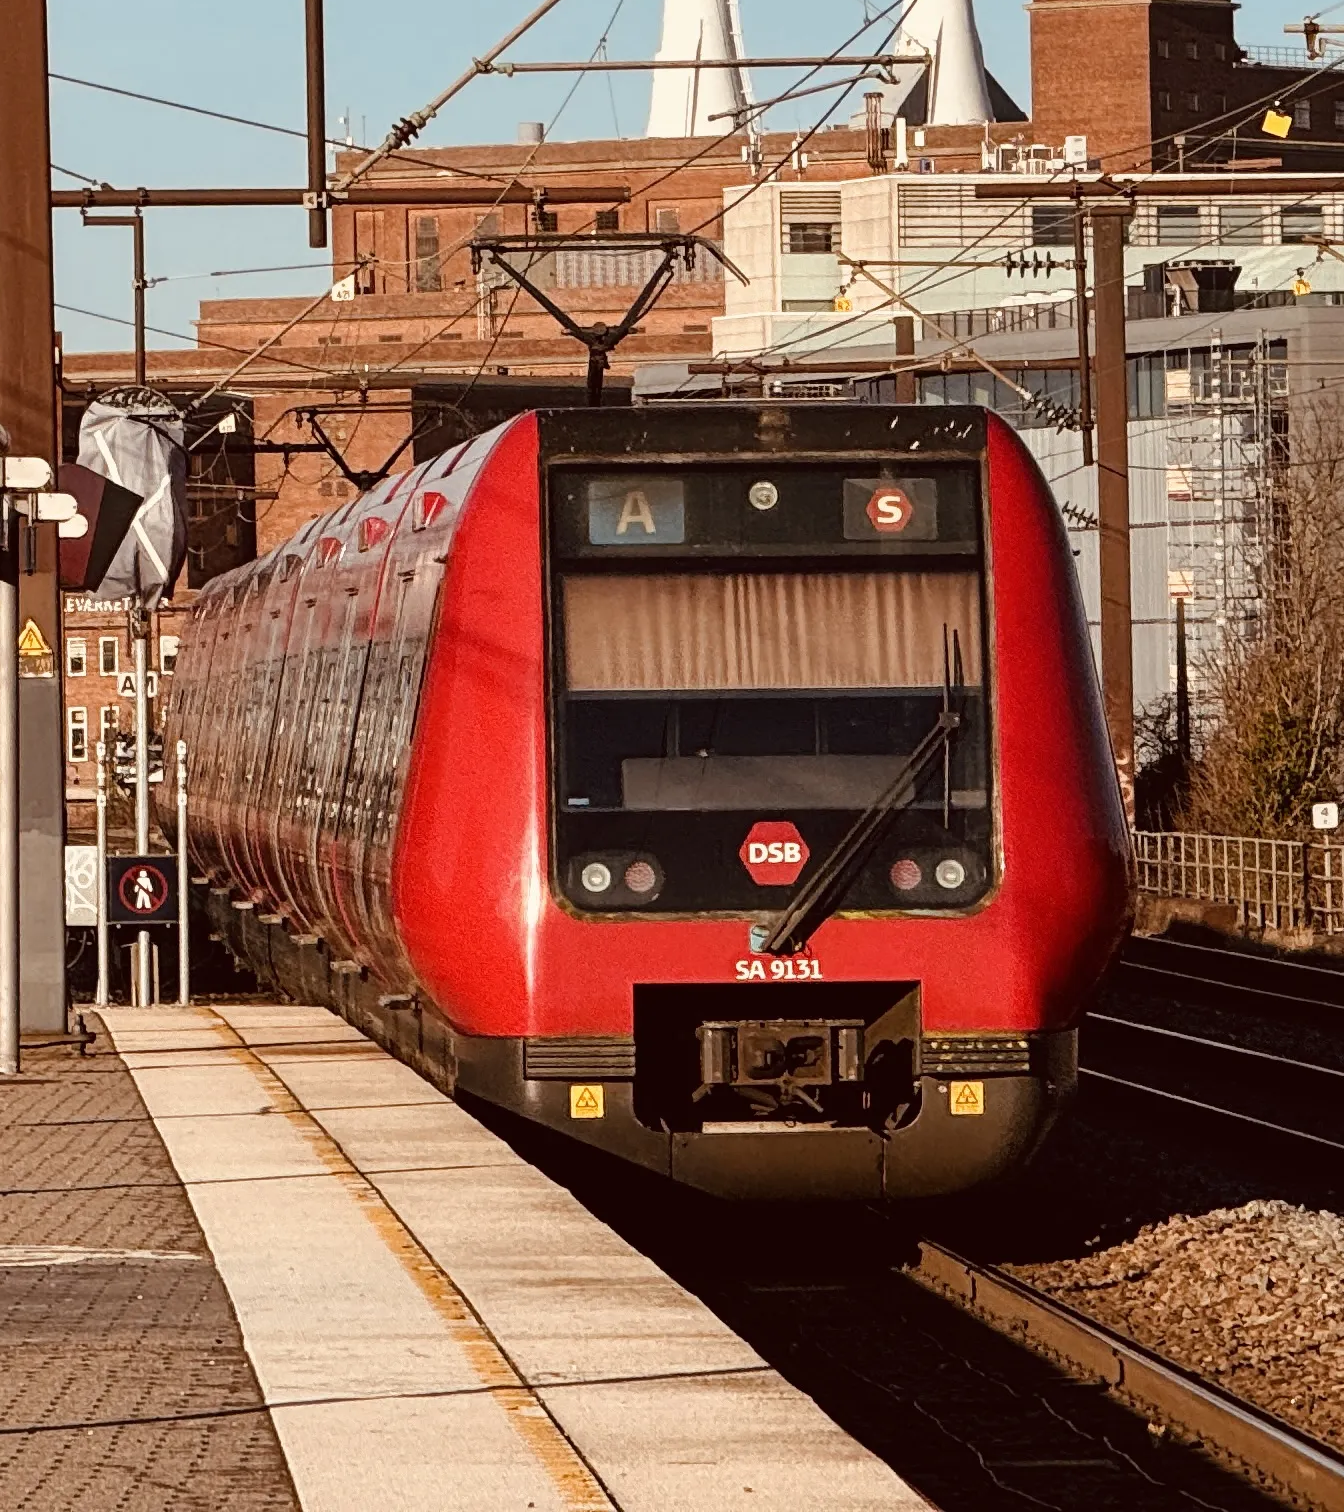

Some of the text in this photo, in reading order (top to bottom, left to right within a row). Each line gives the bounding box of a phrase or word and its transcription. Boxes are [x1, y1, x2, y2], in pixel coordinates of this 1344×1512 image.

[616, 490, 656, 535] A
[877, 495, 903, 524] S
[748, 842, 802, 864] DSB
[735, 959, 823, 981] SA 9131
